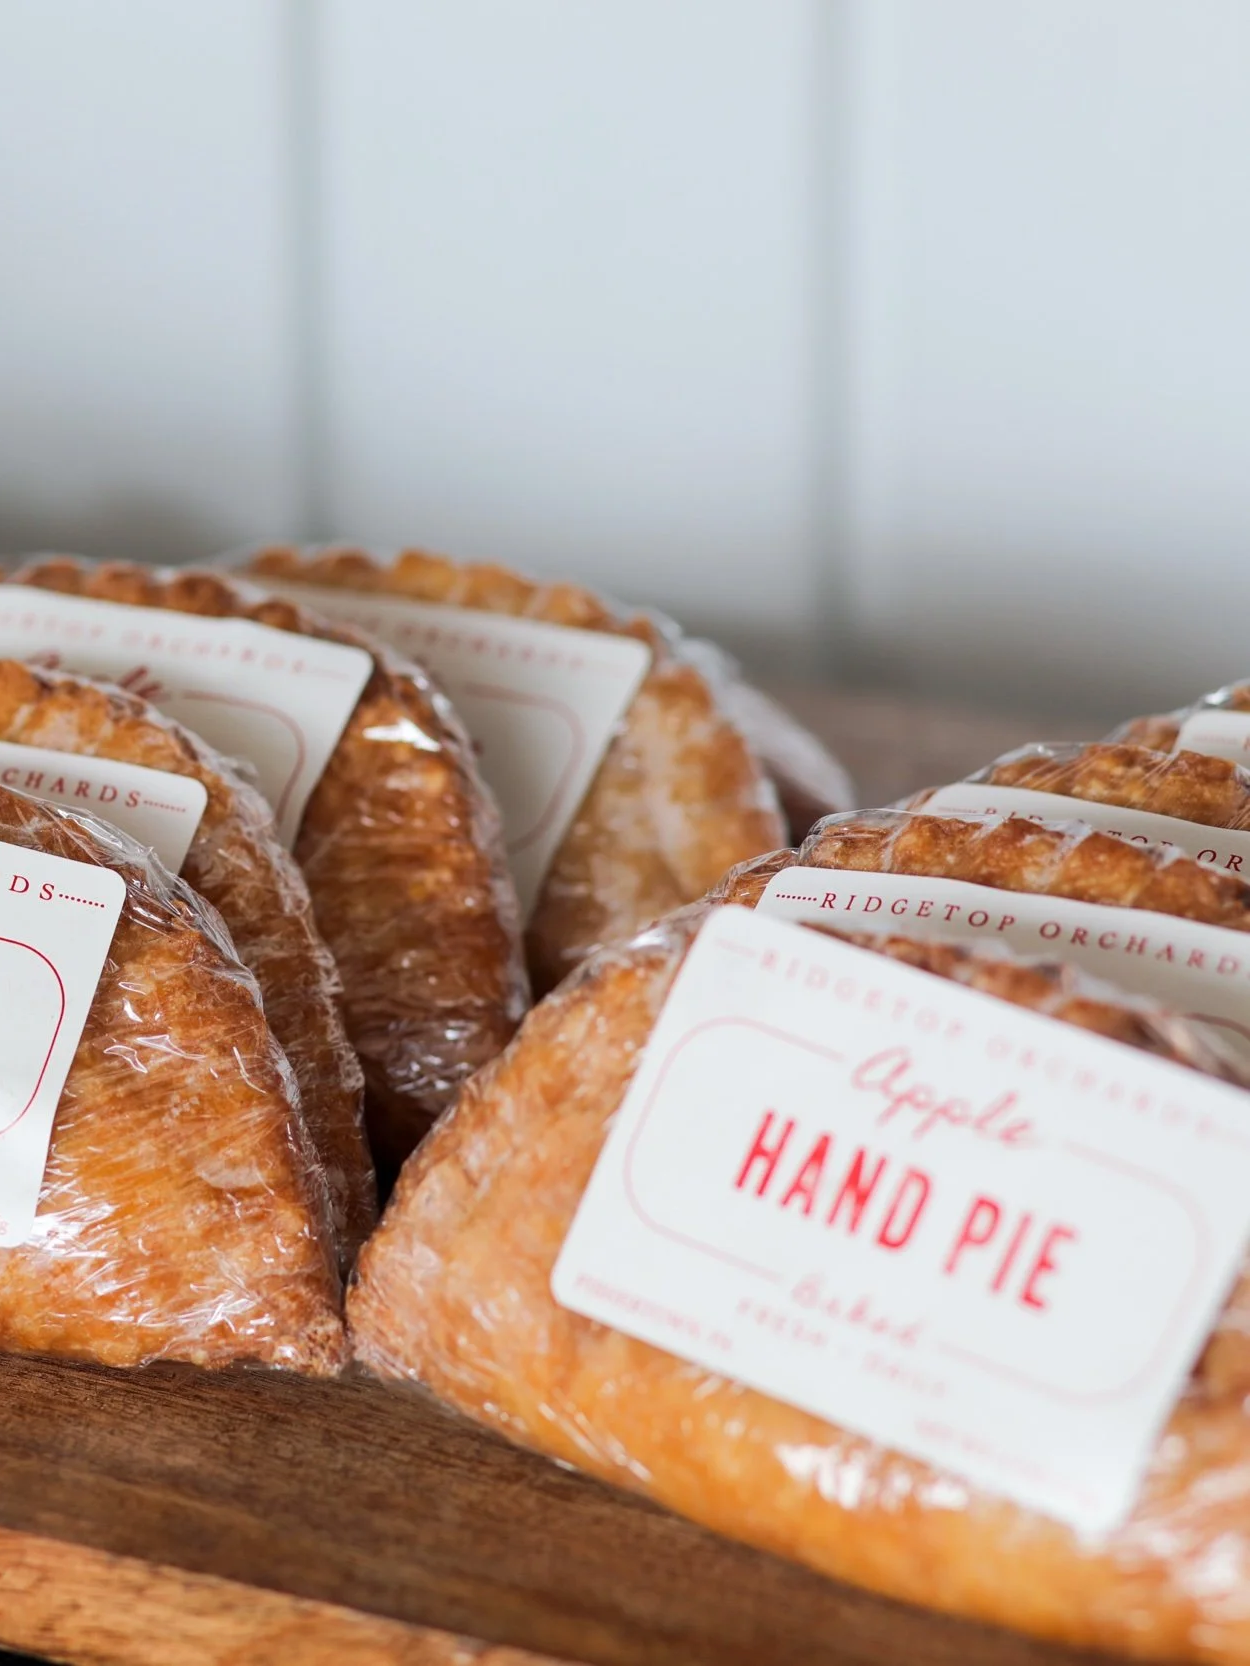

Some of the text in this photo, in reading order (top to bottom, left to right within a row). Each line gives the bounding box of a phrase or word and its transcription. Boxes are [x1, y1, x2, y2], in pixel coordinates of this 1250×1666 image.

[819, 891, 1250, 980] RIDGETOP ORCHARD
[849, 1044, 1047, 1150] Apple
[733, 1108, 1077, 1313] HAND PIE
